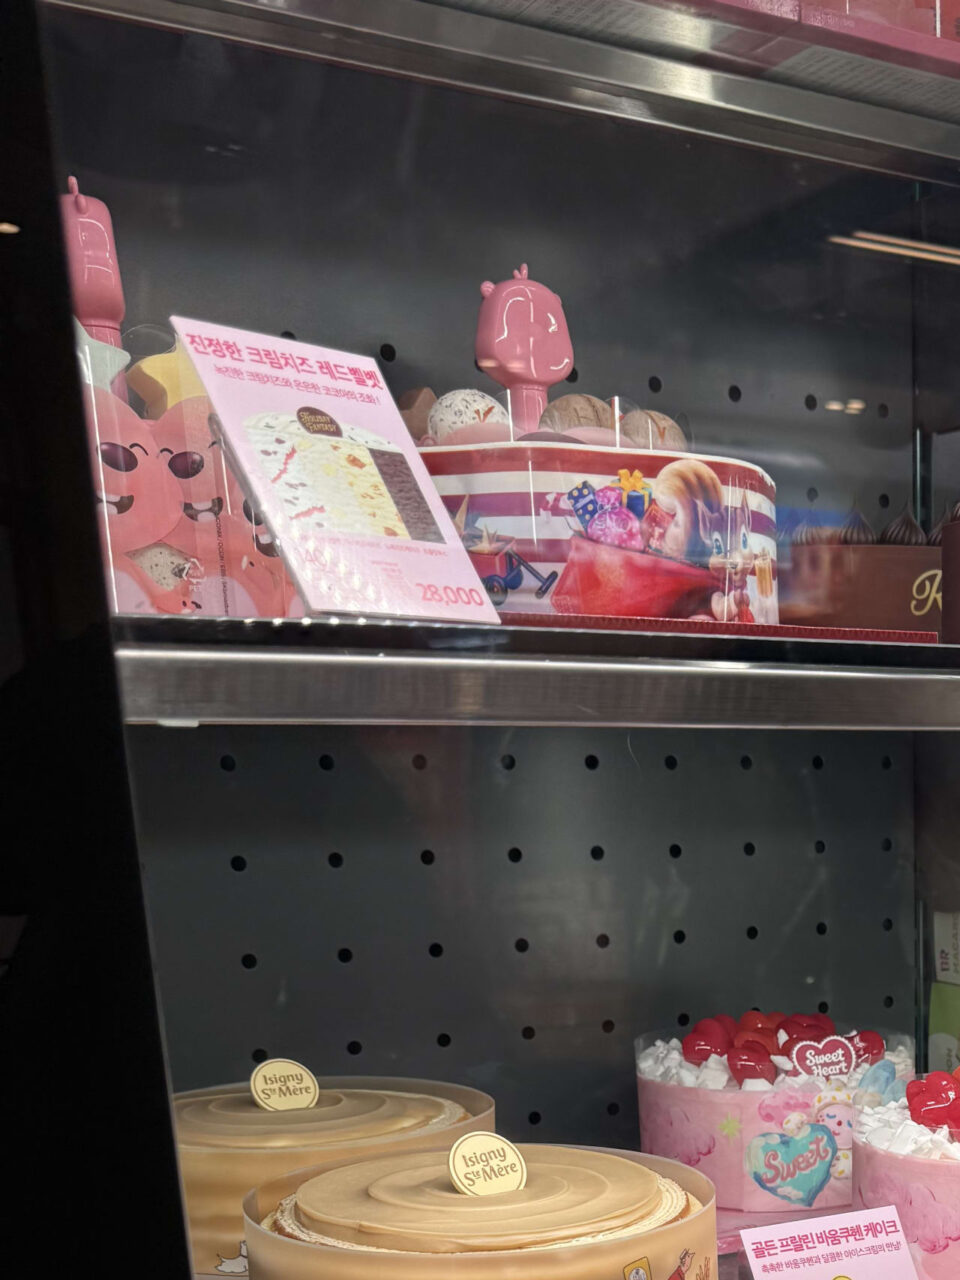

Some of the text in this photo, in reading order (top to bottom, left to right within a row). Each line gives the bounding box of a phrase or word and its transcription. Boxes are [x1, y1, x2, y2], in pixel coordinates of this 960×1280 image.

[186, 333, 383, 390] 진정한 크림치즈 레드벨벳
[415, 583, 485, 606] 28,000
[805, 1048, 845, 1065] Sweet
[263, 1071, 304, 1087] Isigny
[812, 1060, 848, 1077] Heart
[278, 1084, 311, 1098] Mère
[462, 1147, 507, 1168] Isigny
[762, 1137, 830, 1184] Sweet
[481, 1161, 518, 1182] Mère
[751, 1220, 900, 1259] 골든 프랄린 바움쿠헨 케이크
[821, 1252, 843, 1264] 달콤한
[844, 1244, 885, 1260] 아이스크림의
